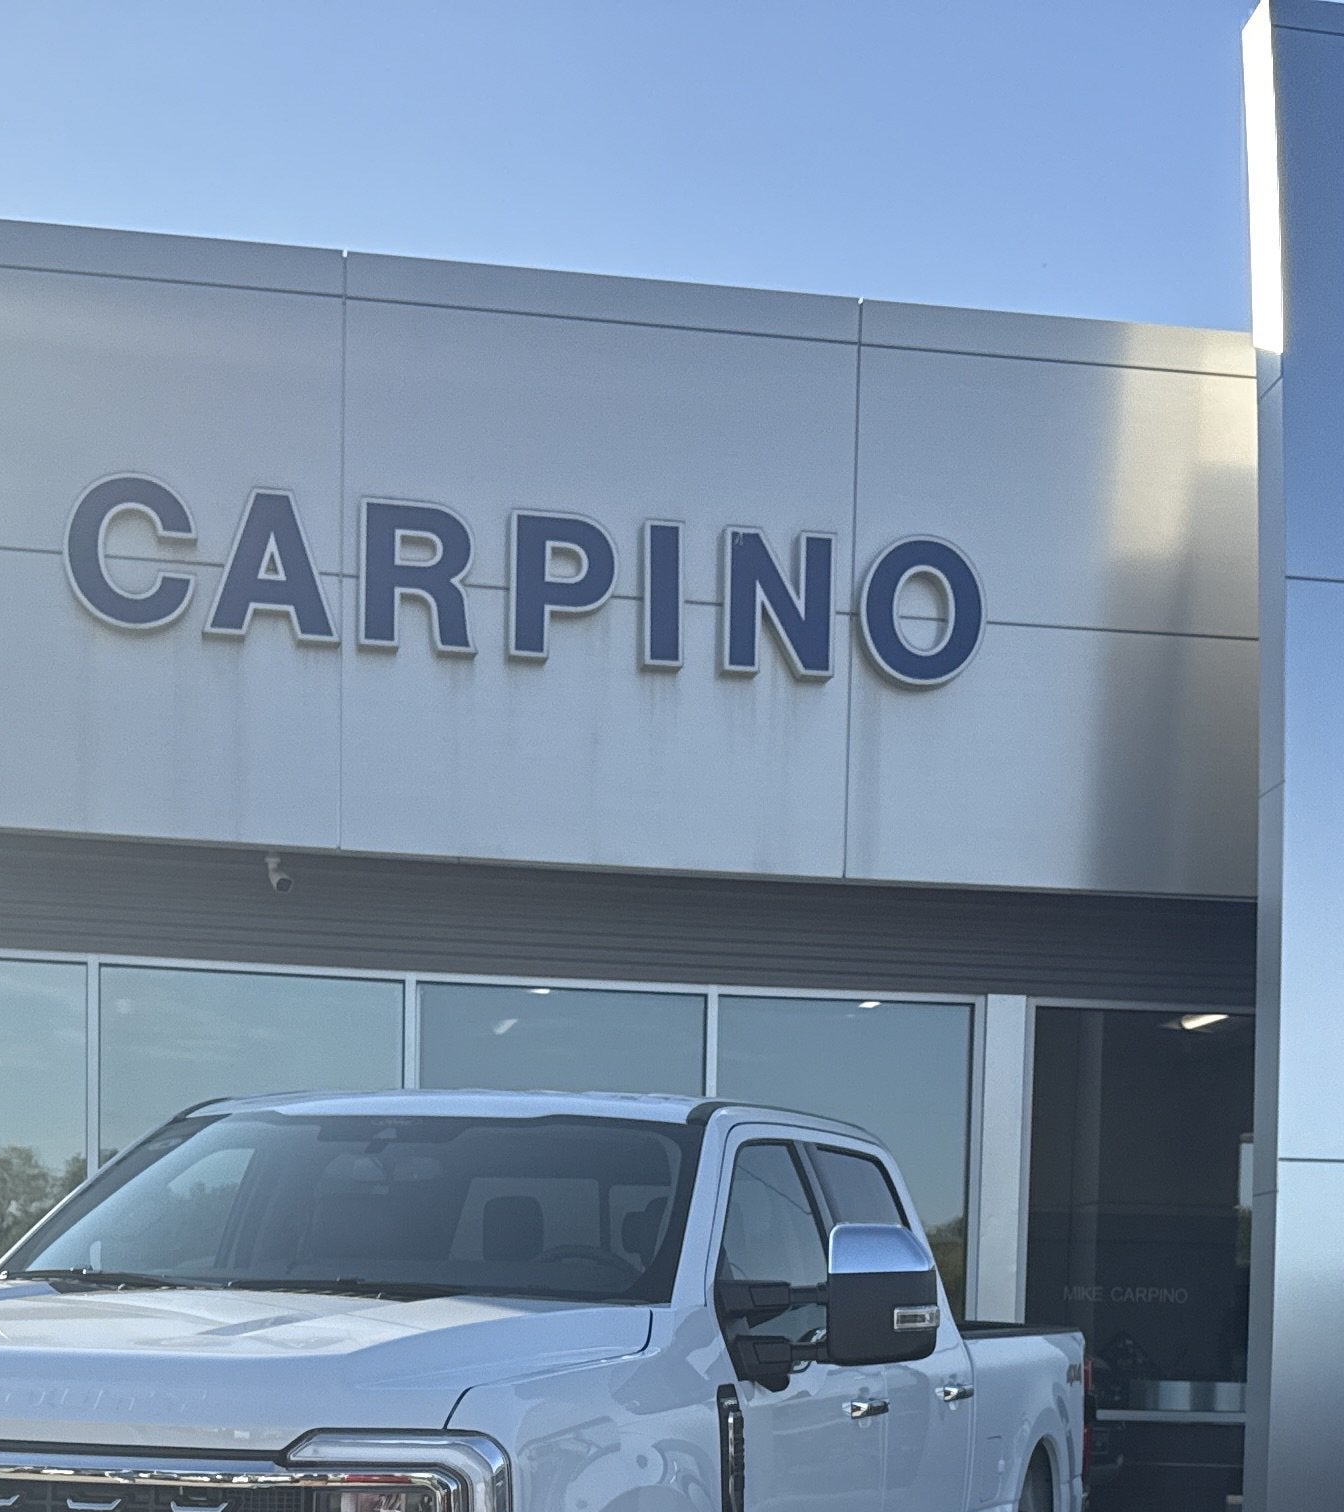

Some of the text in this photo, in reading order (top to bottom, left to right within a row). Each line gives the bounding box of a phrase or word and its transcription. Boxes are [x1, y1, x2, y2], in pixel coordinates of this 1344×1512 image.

[62, 471, 987, 686] CARPINO
[1063, 1286, 1189, 1303] MIKE CARPINO
